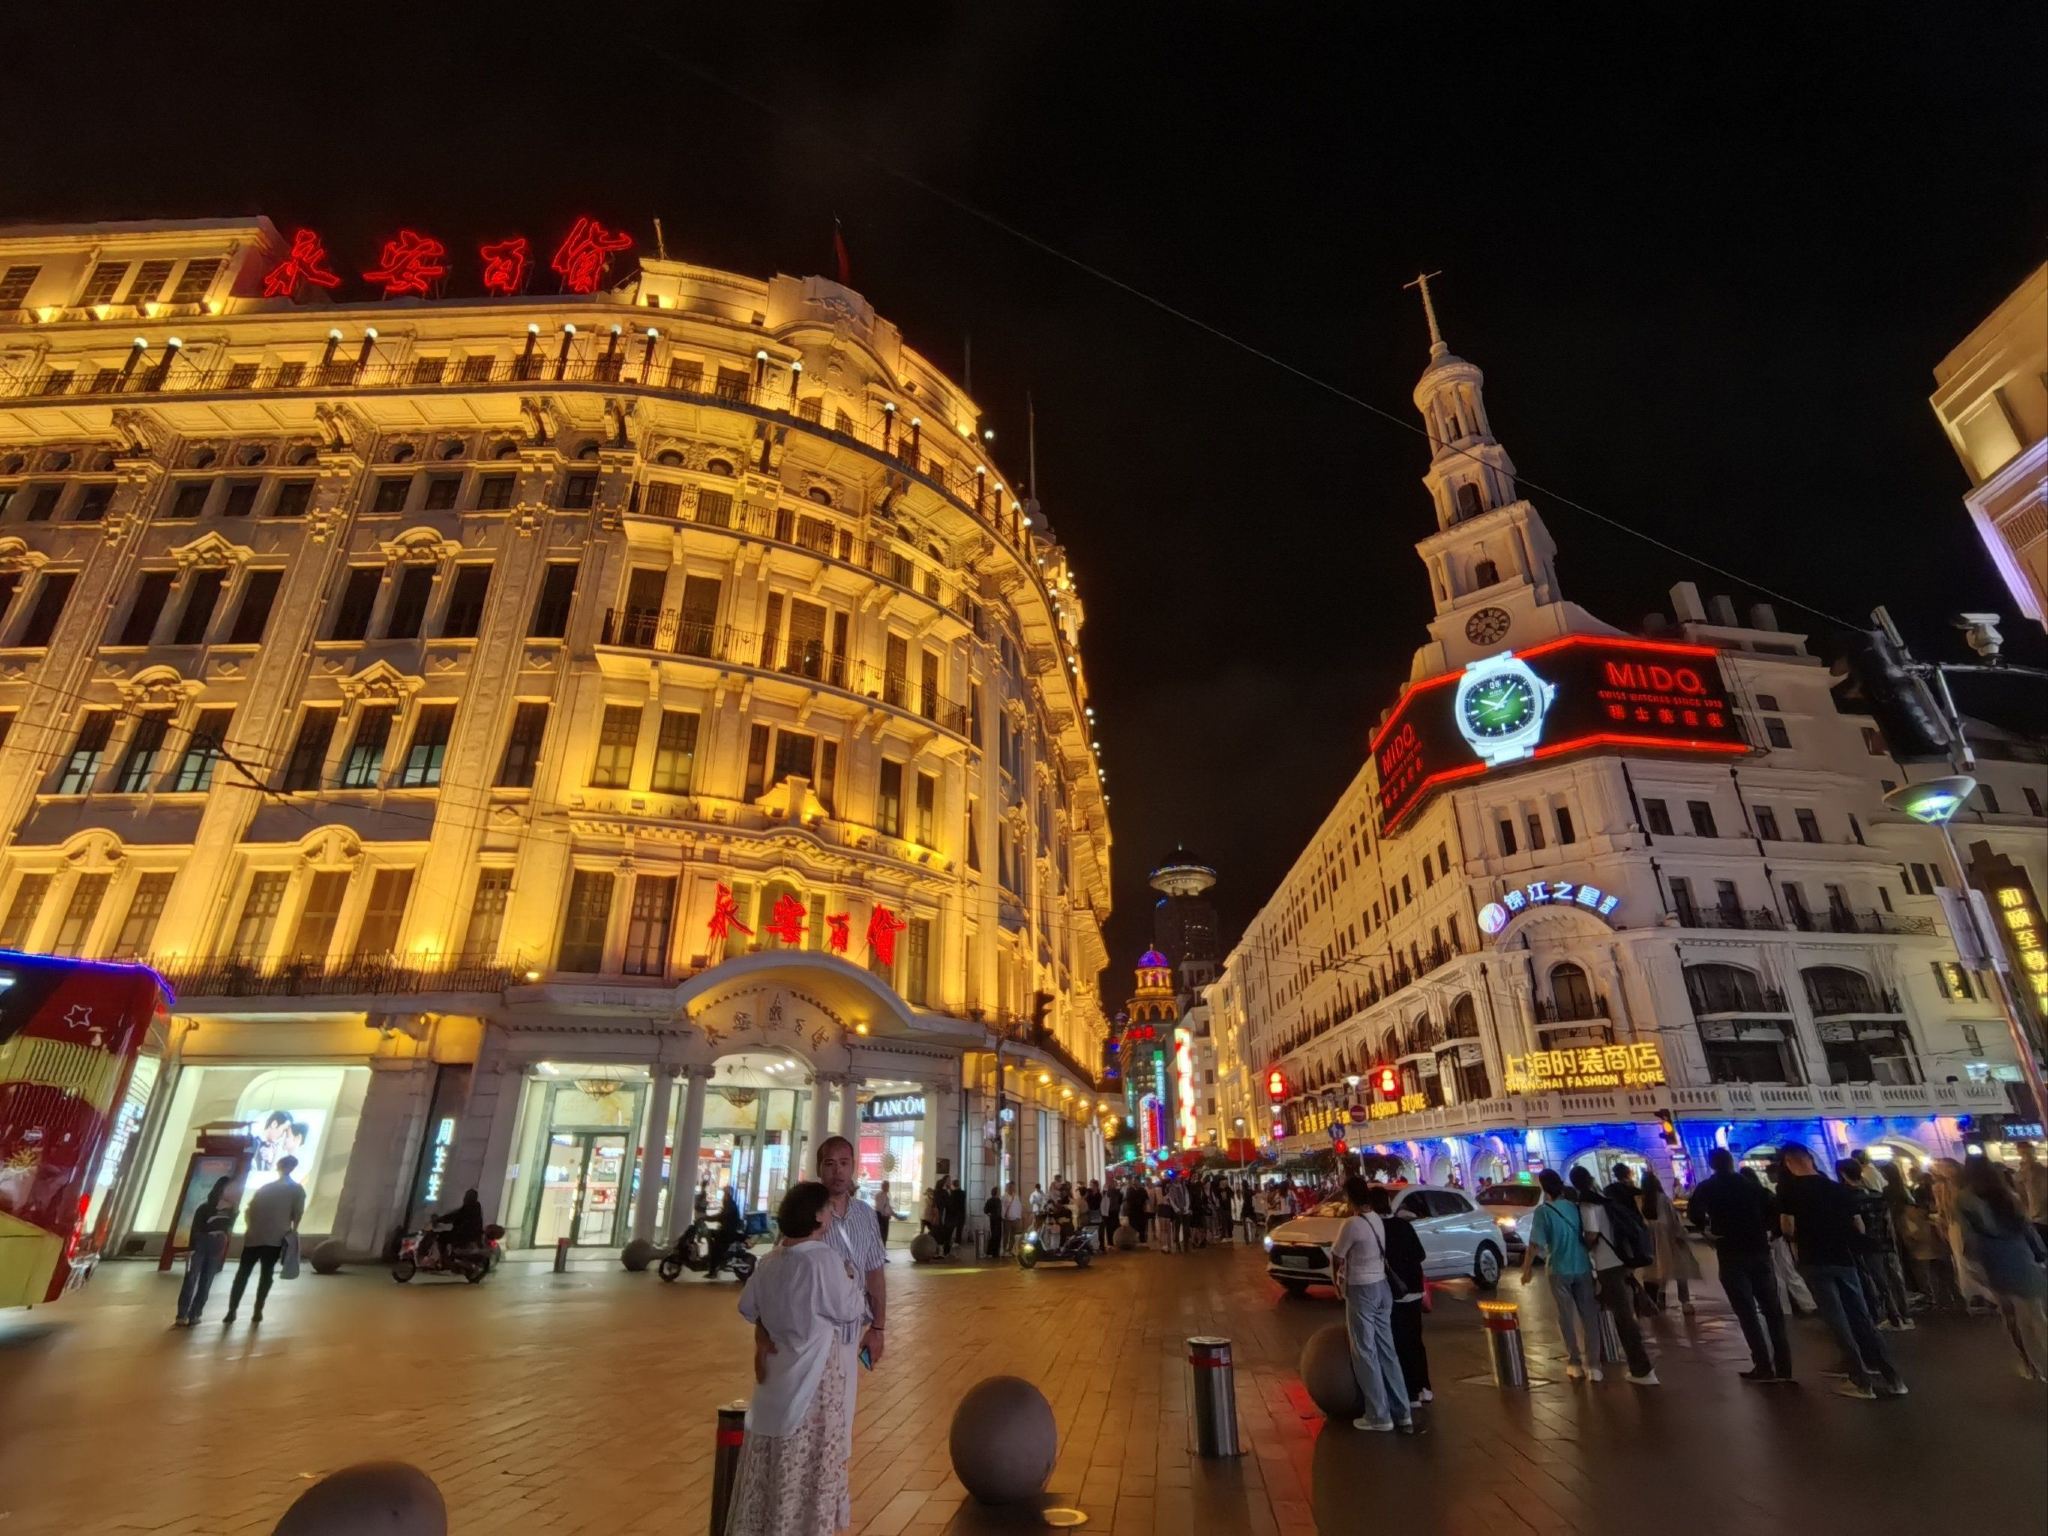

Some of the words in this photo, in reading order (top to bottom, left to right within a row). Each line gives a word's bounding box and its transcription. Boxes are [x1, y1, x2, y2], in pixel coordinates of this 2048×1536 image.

[1605, 661, 1702, 694] MIDO
[1382, 723, 1413, 776] MIDO
[1505, 1042, 1661, 1078] 上海时装商店
[1505, 1076, 1563, 1091] SHANGHAI
[1567, 1074, 1619, 1088] FASHION
[1624, 1070, 1666, 1084] STORE
[1370, 1101, 1399, 1119] FASHION
[1401, 1092, 1427, 1113] STORE
[424, 1118, 455, 1201] 周生生
